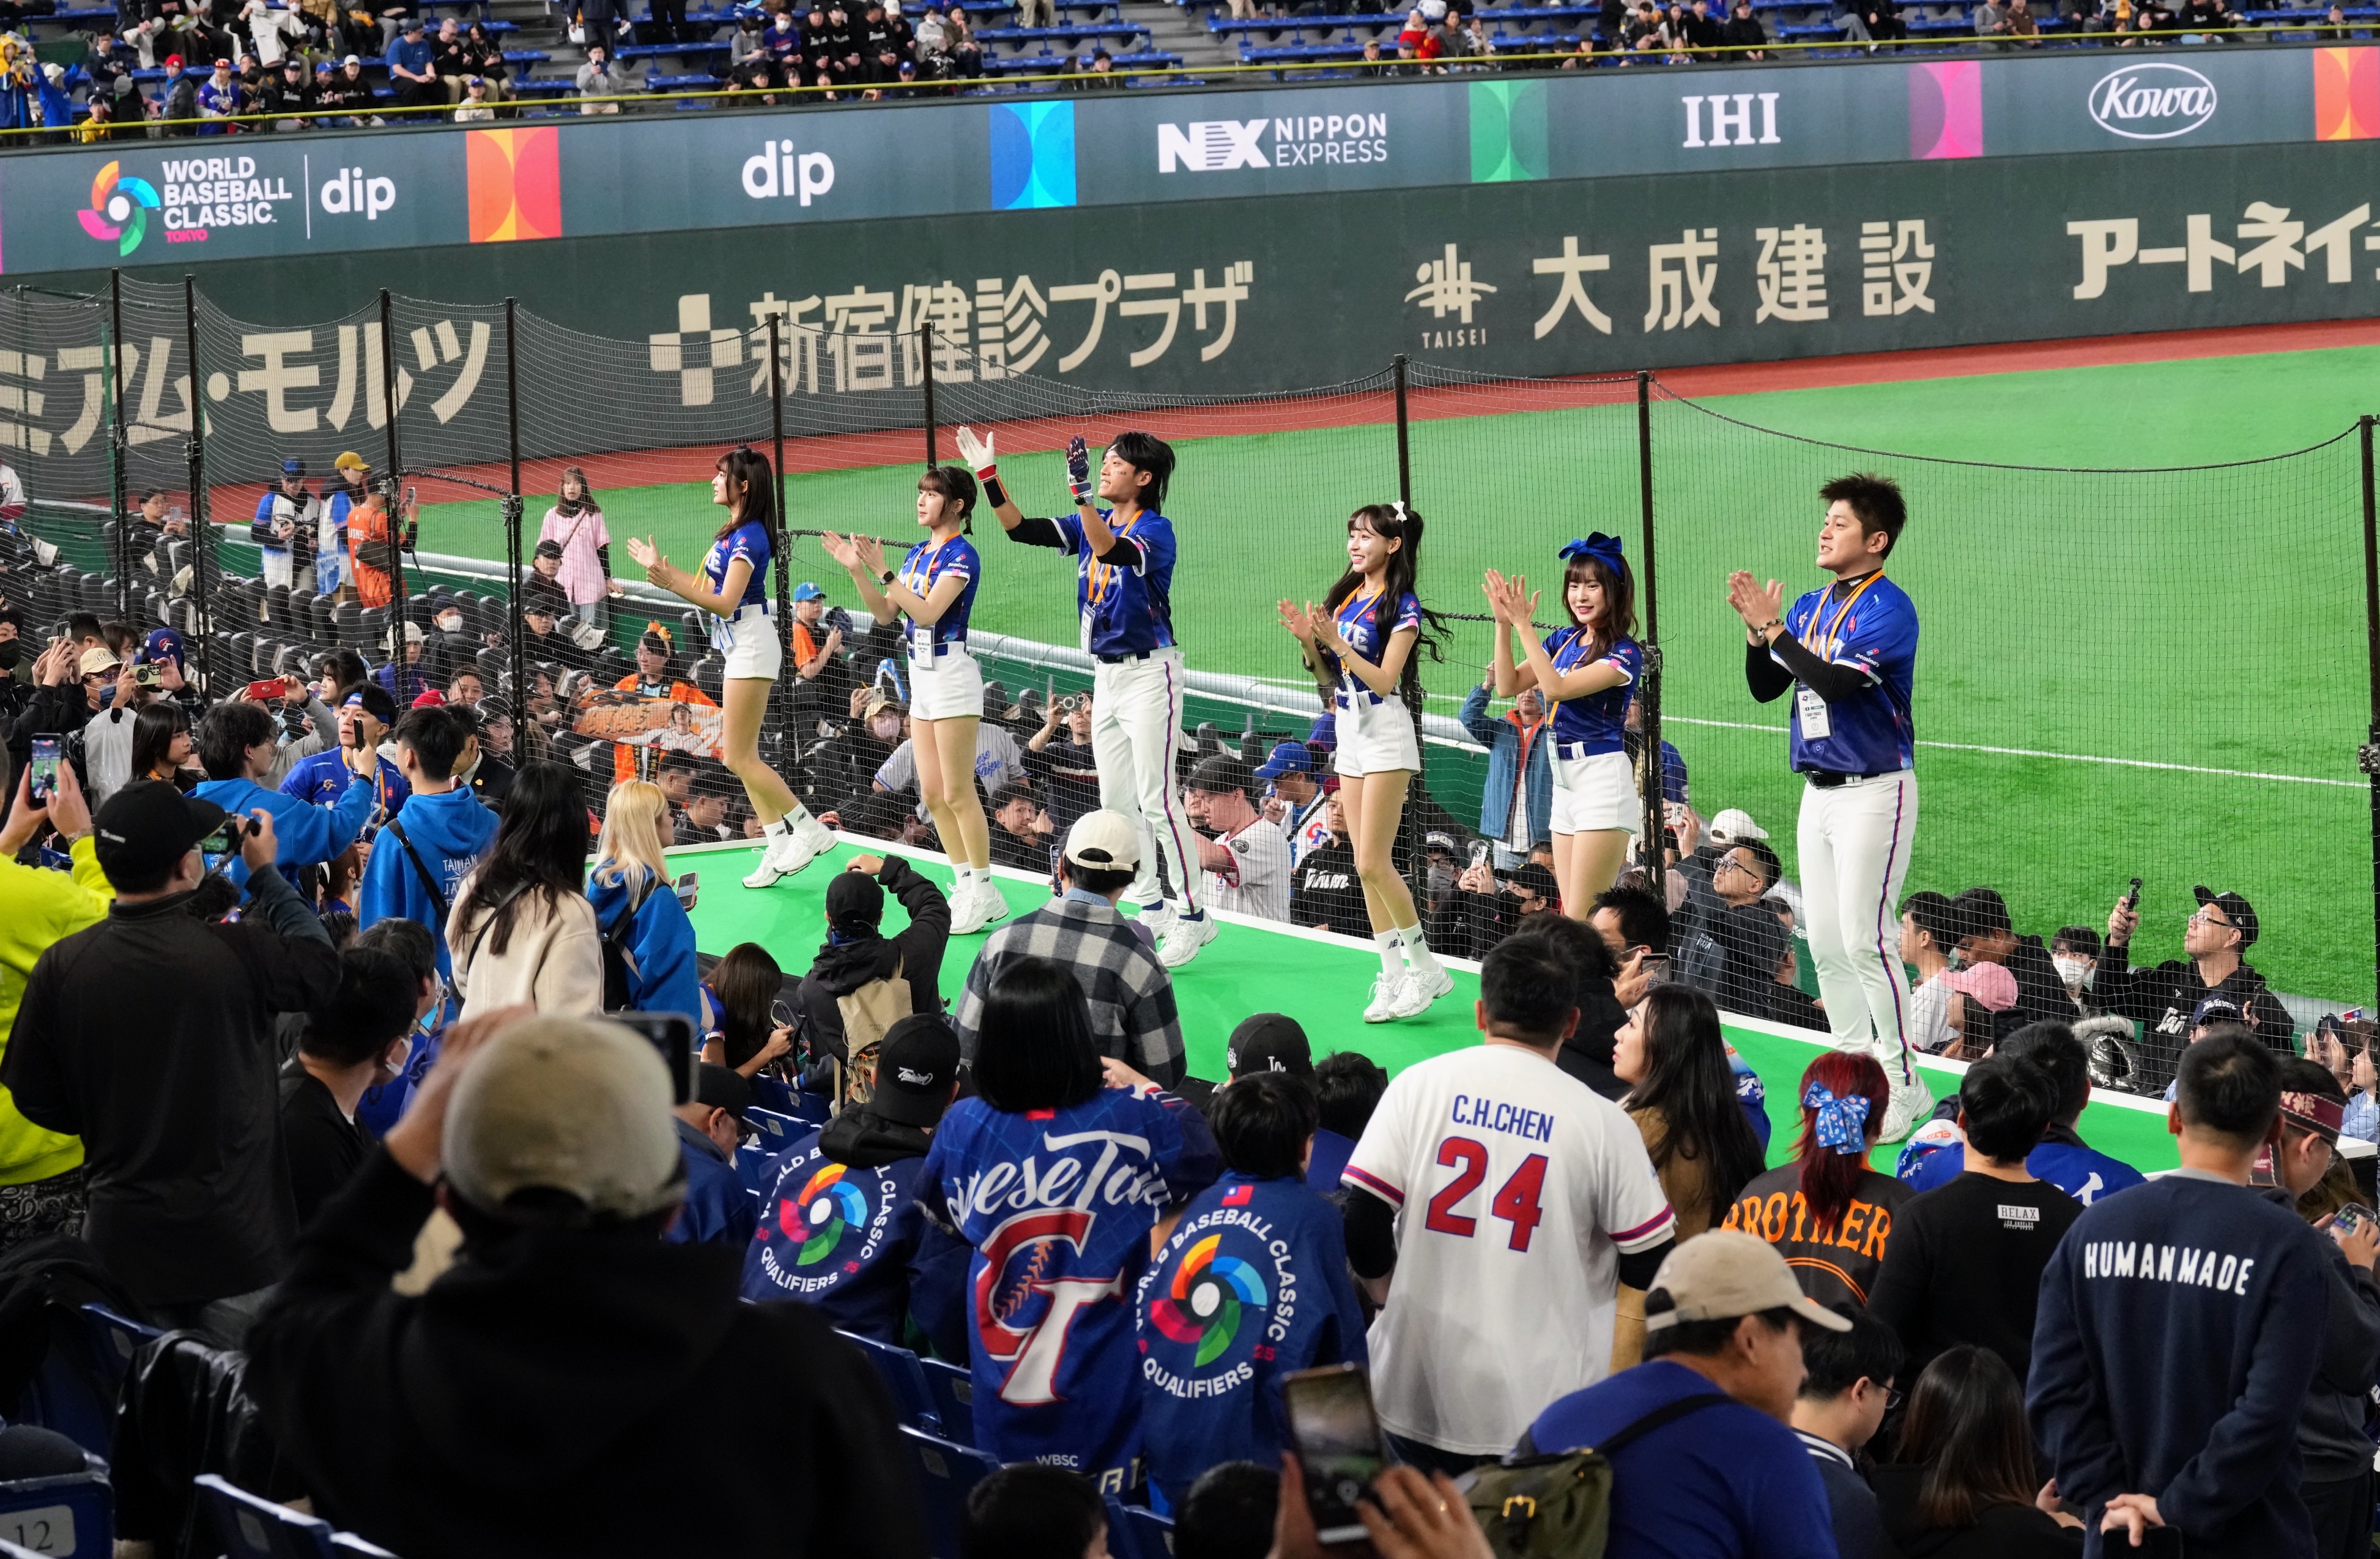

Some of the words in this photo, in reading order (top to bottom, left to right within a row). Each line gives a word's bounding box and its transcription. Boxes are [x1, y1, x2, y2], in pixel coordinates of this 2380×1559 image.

[2100, 77, 2212, 119] Kowa
[1275, 113, 1387, 142] NIPPON
[1682, 92, 1781, 147] IHI
[162, 156, 256, 183] WORLD
[742, 140, 835, 207] dip
[1276, 140, 1388, 168] EXPRESS
[163, 177, 292, 207] BASEBALL
[321, 166, 396, 220] dip
[163, 201, 273, 229] CLASSIC
[165, 229, 209, 243] TOKYO
[2066, 201, 2380, 300] アートネイ
[1533, 219, 1936, 340] 大成建設
[750, 260, 1253, 396] 新宿健診プラザ
[1422, 329, 1487, 349] TAISEI
[1135, 534, 1151, 553] Domino's
[1855, 653, 1880, 668] Domino's
[1452, 1094, 1555, 1143] C.H.CHEN
[1425, 1135, 1549, 1252] 24
[2001, 1207, 2036, 1219] RELAX
[861, 1180, 897, 1259] CLASSIC
[1171, 1208, 1273, 1249] BASEBALL
[761, 1246, 838, 1293] QUALIFIERS
[843, 1260, 860, 1273] 25
[1267, 1240, 1297, 1342] CLASSIC
[1143, 1357, 1254, 1398] QUALIFIERS
[1035, 1454, 1079, 1467] WBSC
